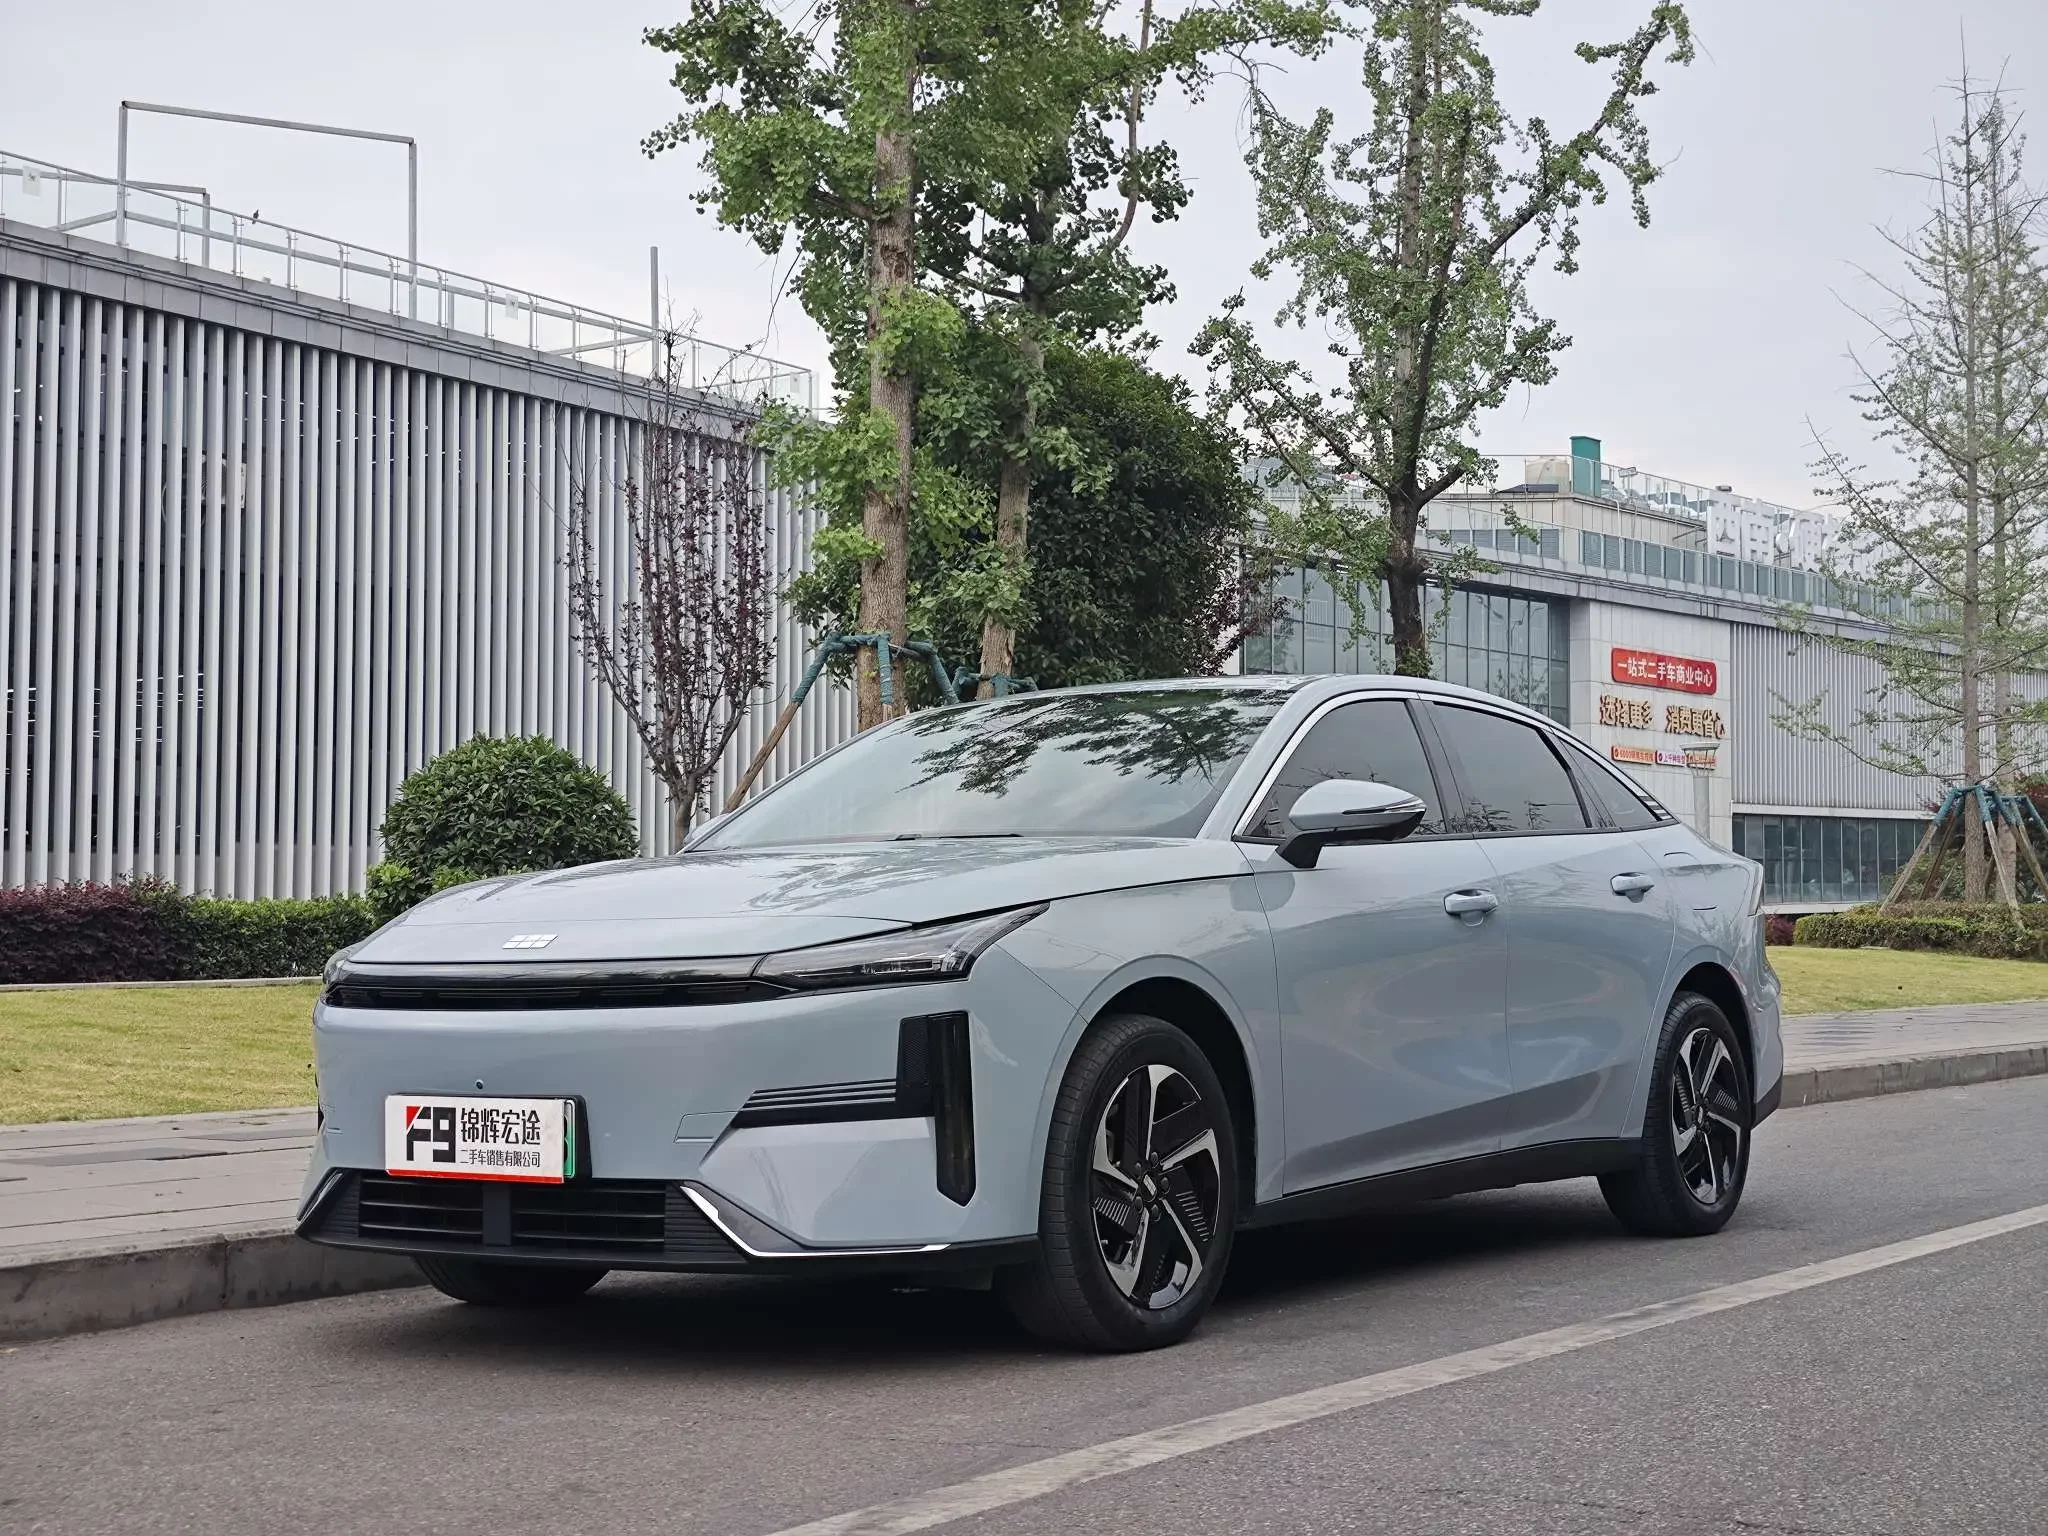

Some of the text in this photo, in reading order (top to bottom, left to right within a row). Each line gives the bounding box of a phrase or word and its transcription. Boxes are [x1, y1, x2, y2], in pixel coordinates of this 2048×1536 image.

[1617, 656, 1713, 688] 一站式二手车商业中心
[1600, 695, 1725, 739] 选择更多 消费更省心
[460, 1107, 541, 1146] 锦辉宏途
[459, 1149, 541, 1168] 二手车销售有限公司
